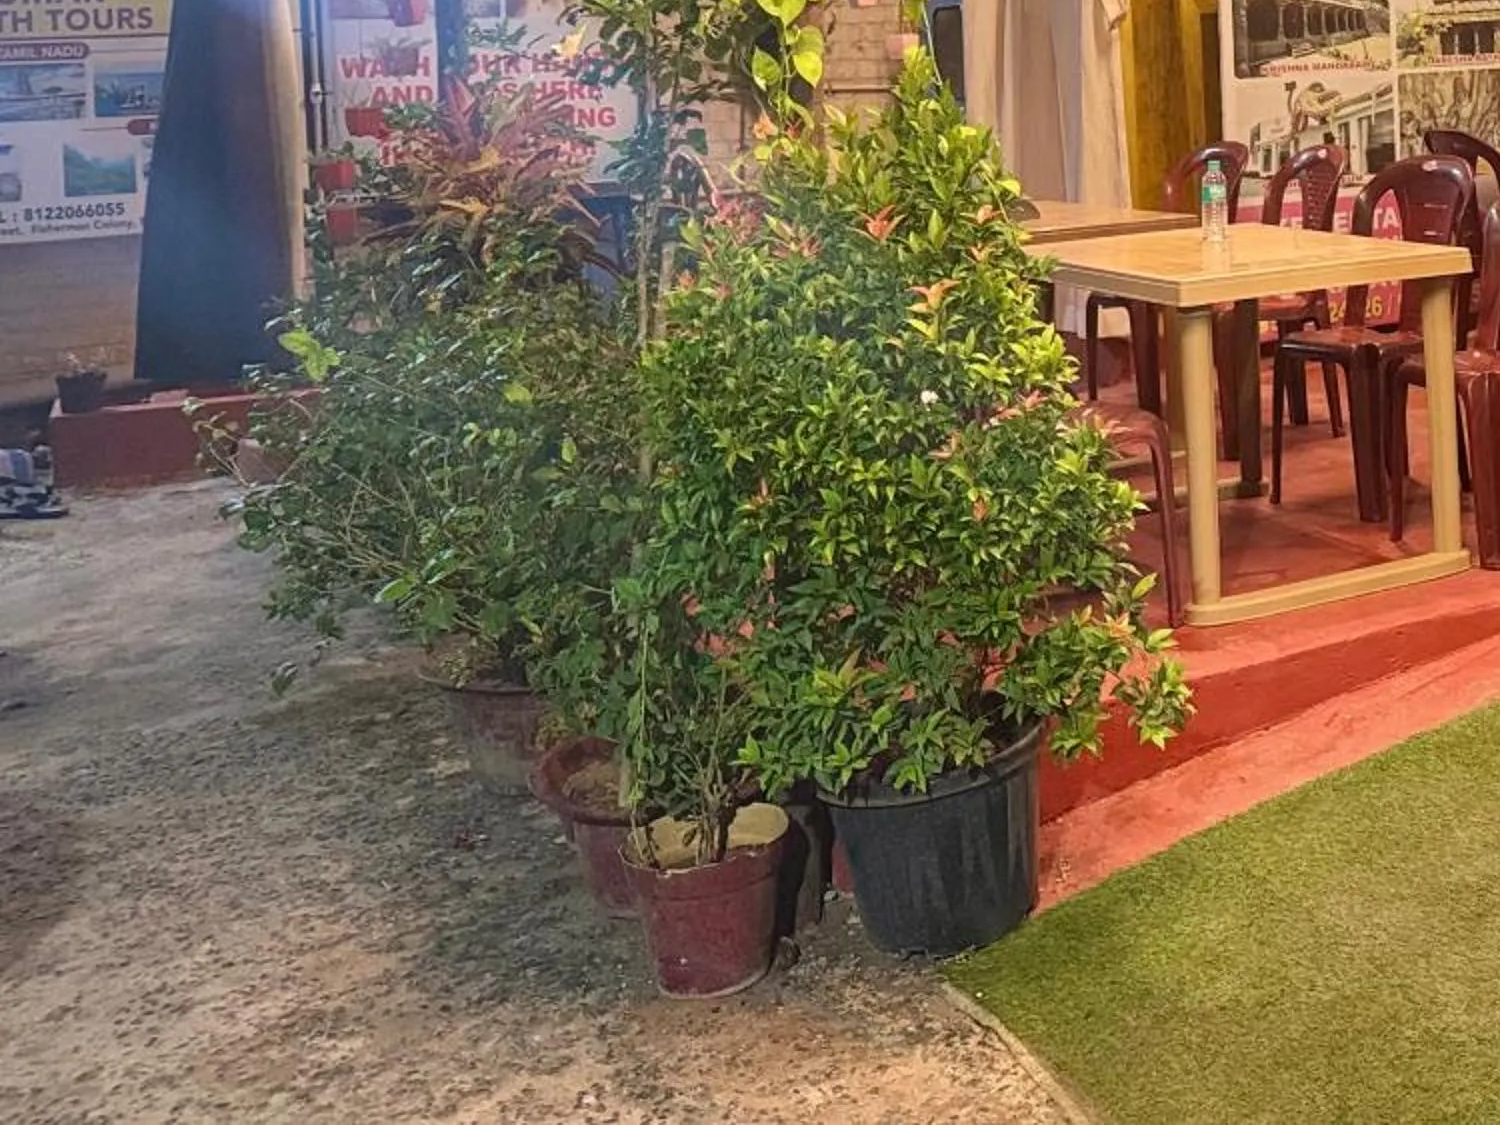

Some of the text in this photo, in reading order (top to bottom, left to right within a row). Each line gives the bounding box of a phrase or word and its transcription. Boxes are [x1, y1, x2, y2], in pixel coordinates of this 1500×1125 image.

[46, 7, 153, 31] TOURS
[41, 45, 84, 58] NADU
[23, 203, 125, 222] 8122066055
